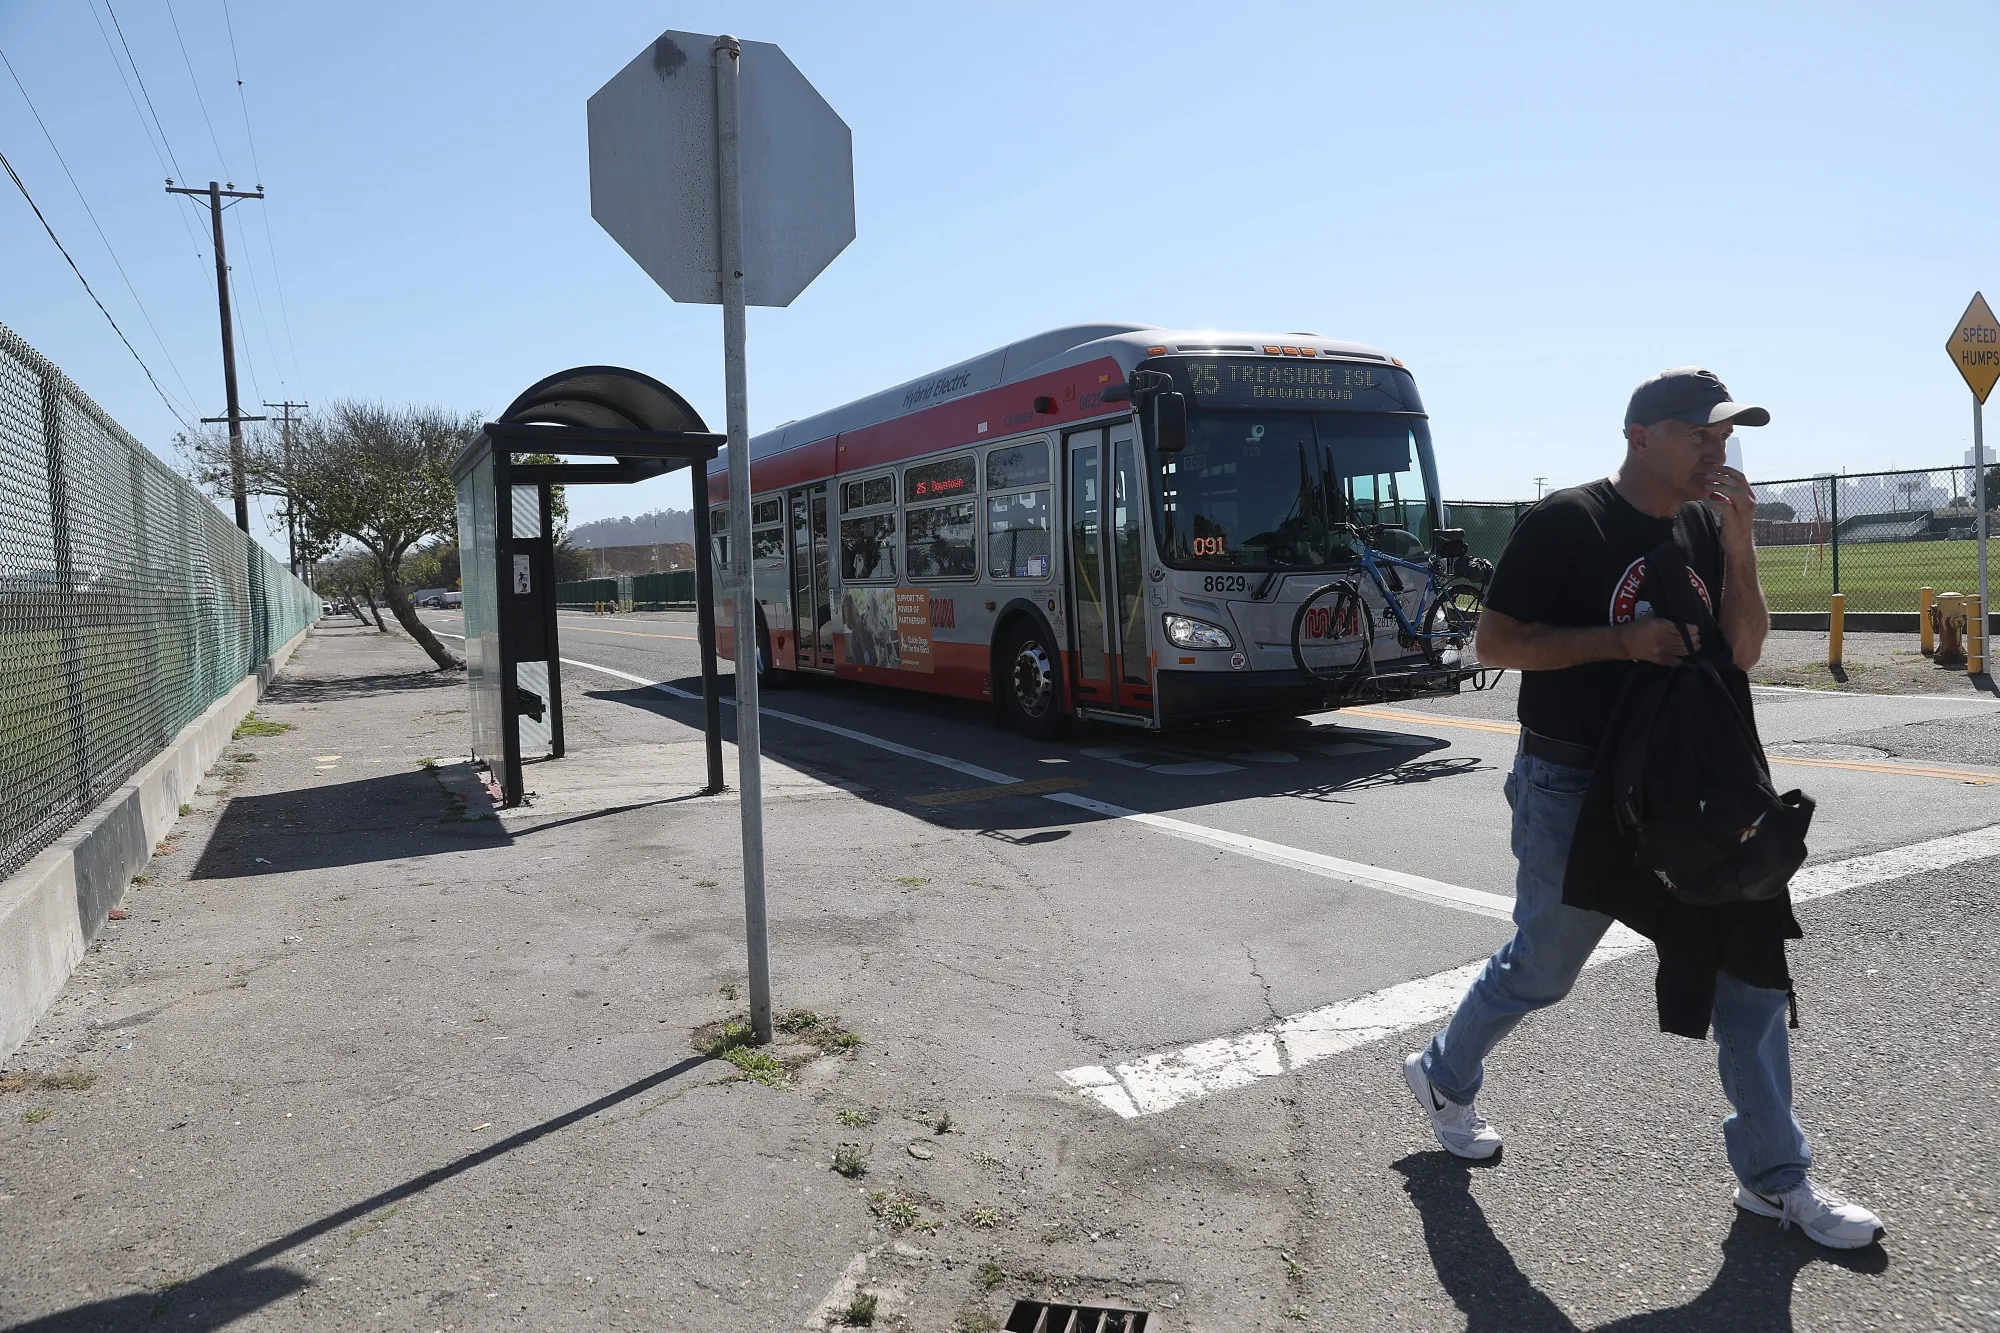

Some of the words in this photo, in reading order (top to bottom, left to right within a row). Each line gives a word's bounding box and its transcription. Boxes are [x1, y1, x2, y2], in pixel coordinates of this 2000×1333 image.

[1963, 327, 1997, 343] SPEED
[1962, 350, 1999, 366] HUMPS
[1188, 363, 1220, 396] 25
[1228, 365, 1333, 385] TREASURE
[1343, 368, 1375, 387] ISL
[902, 384, 934, 410] Hybrid
[933, 369, 972, 397] Electric
[1253, 385, 1353, 400] Downtown
[916, 482, 927, 495] 25
[931, 477, 964, 492] Downtown
[1193, 536, 1226, 556] 091
[1204, 575, 1246, 593] 8629
[1620, 574, 1640, 599] THE
[918, 637, 928, 645] Dogs
